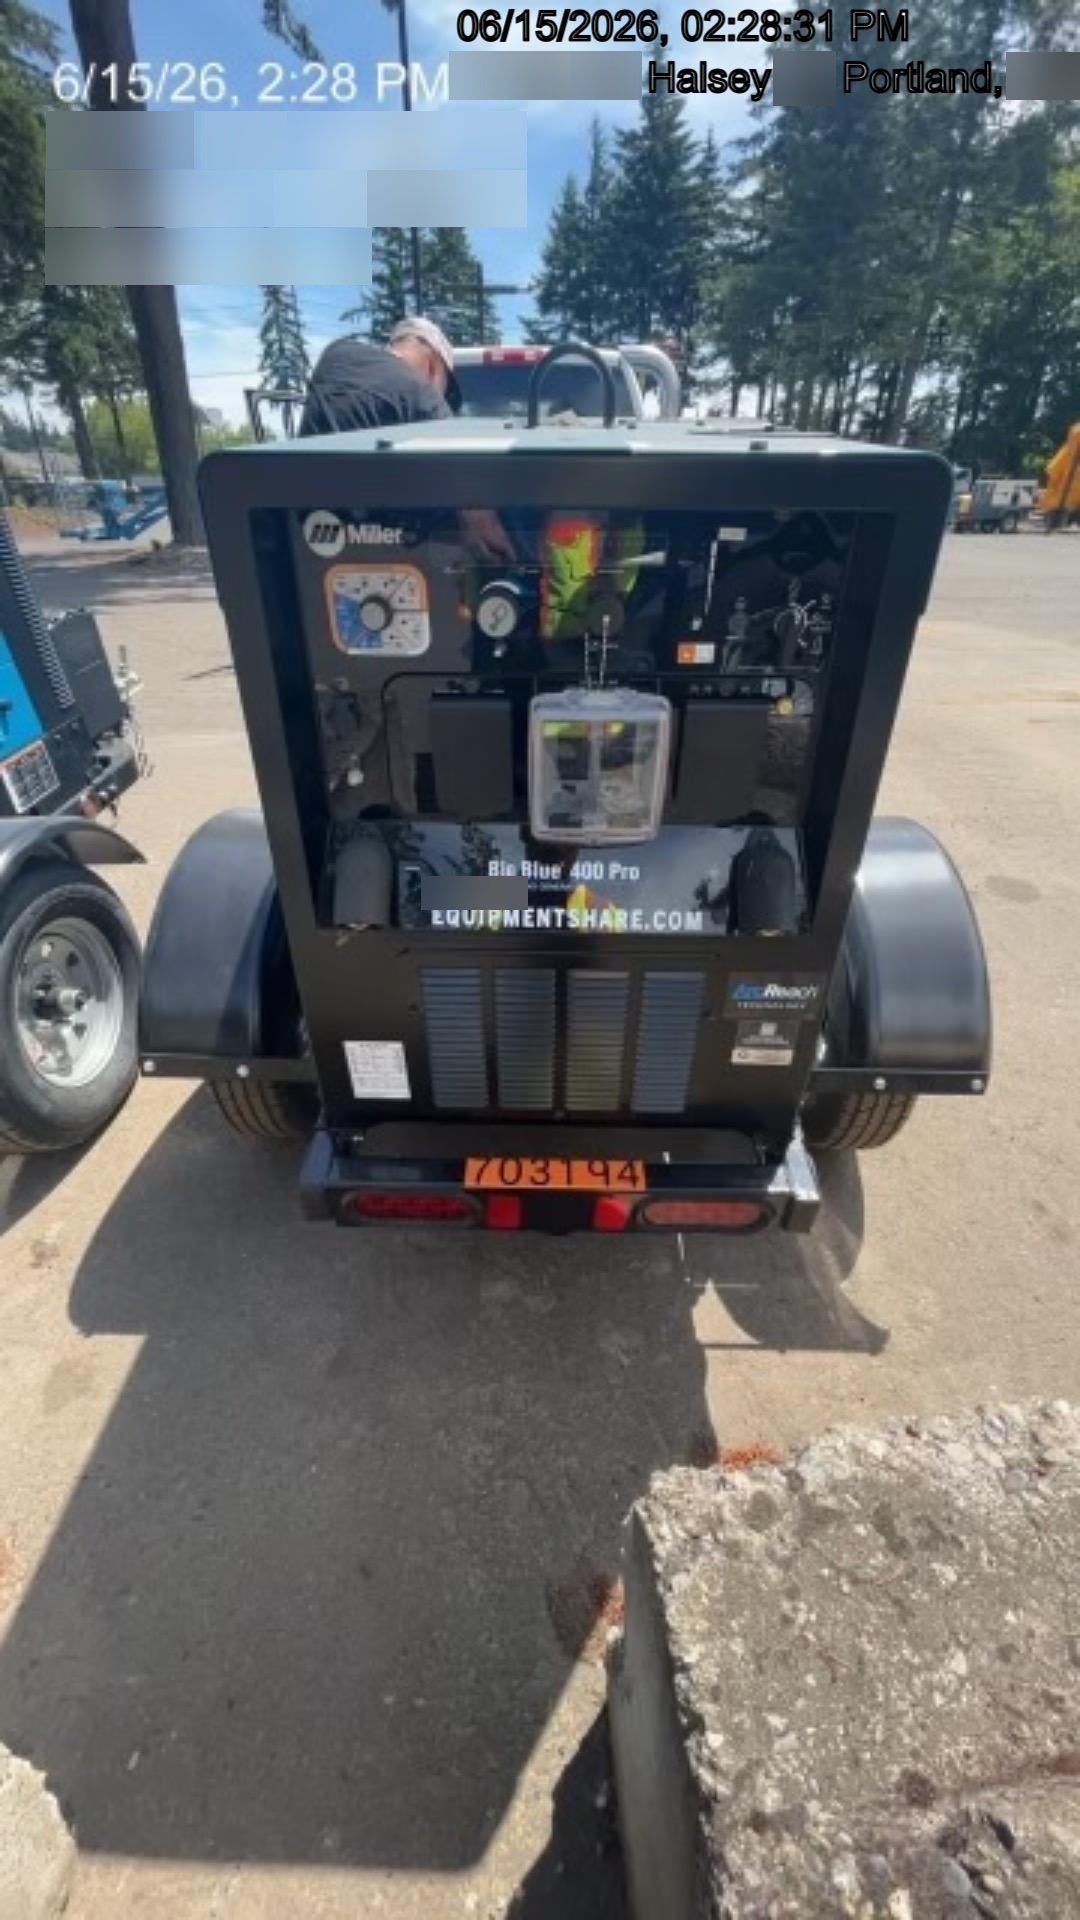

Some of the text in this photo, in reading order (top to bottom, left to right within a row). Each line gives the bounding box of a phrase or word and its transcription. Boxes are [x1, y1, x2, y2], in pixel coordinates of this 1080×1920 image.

[347, 524, 403, 544] Miller
[569, 860, 604, 880] 400
[609, 861, 640, 880] Pro
[431, 908, 704, 932] EQUIPMENTSHARE.COM
[472, 1158, 639, 1187] 703194
